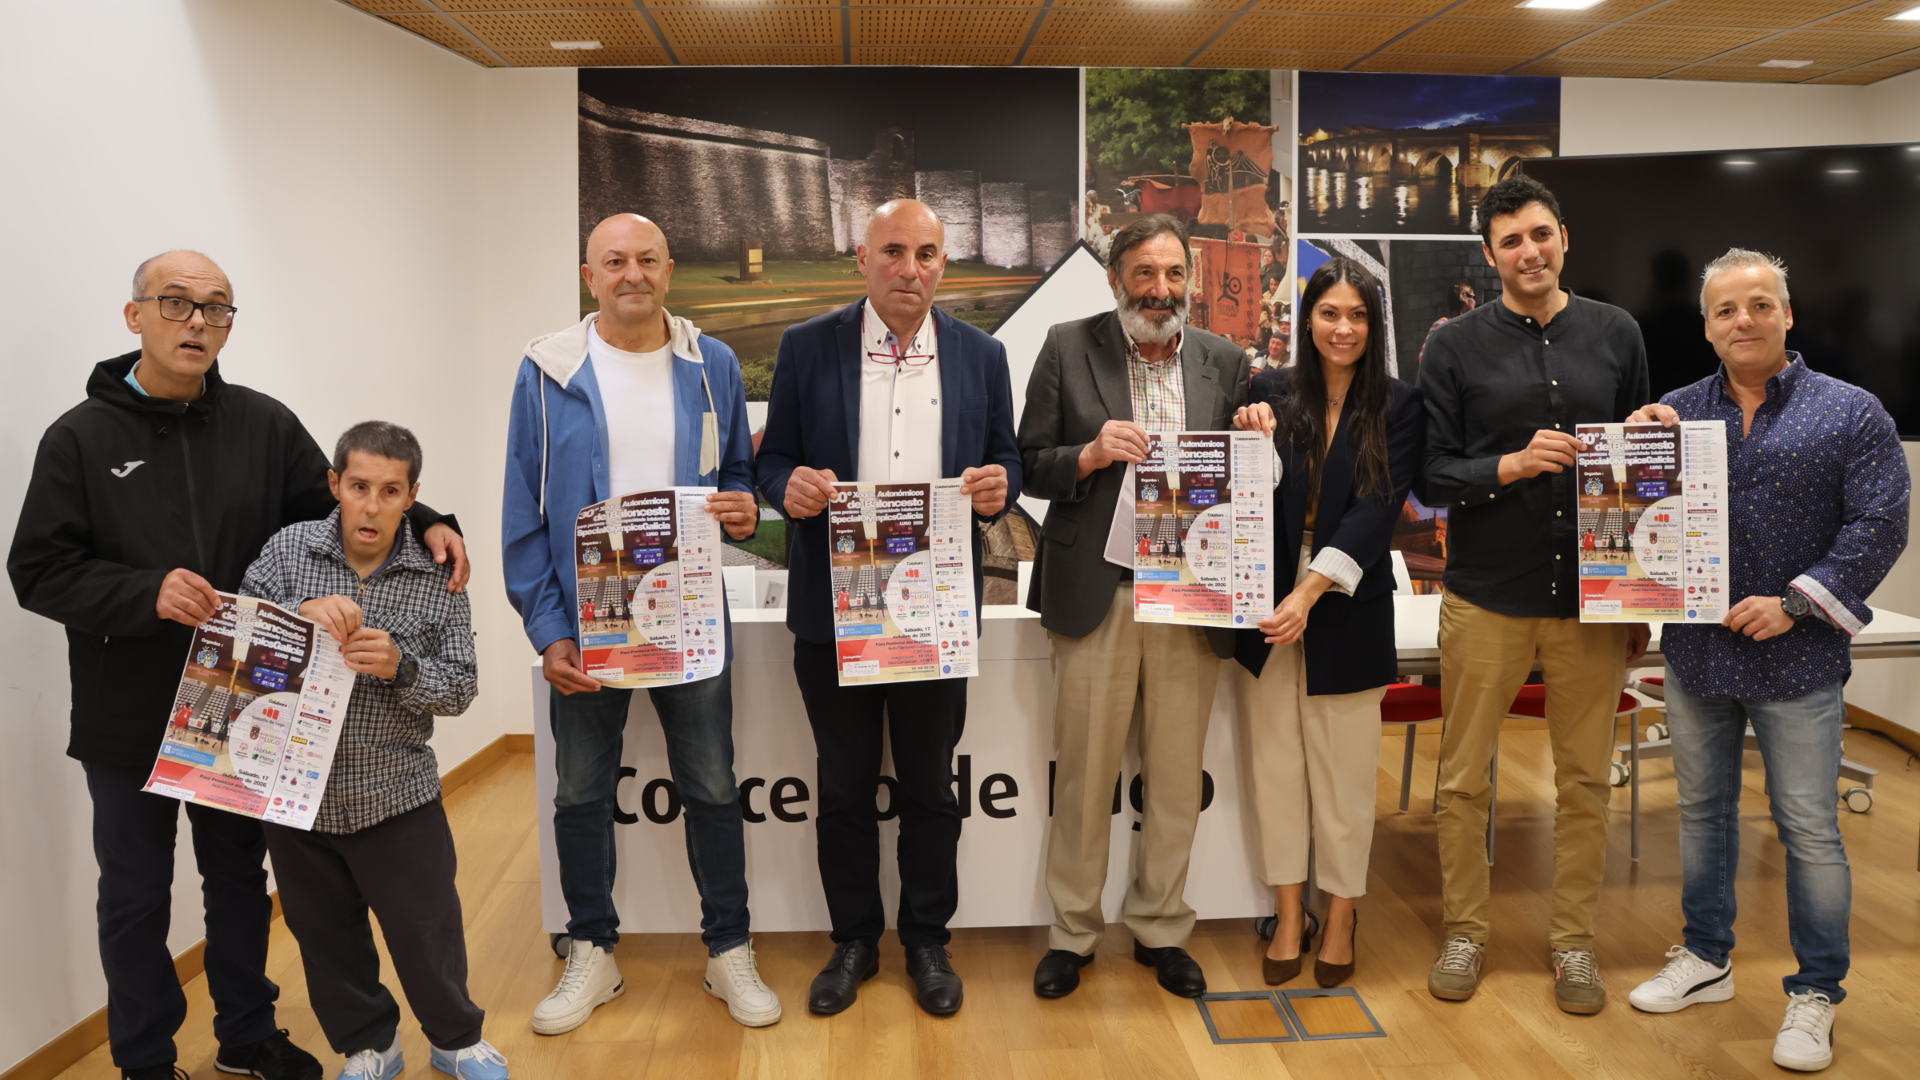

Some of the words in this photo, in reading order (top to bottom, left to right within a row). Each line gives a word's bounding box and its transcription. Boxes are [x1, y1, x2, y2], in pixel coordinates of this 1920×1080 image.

[1595, 442, 1610, 451] de
[1613, 440, 1675, 451] Baloncesto
[1151, 450, 1165, 458] de
[1168, 450, 1225, 459] Baloncesto
[877, 490, 924, 498] Autonómicos
[622, 497, 670, 507] Autonómicos
[847, 500, 862, 509] de
[865, 498, 924, 508] Baloncesto
[593, 513, 606, 521] de
[610, 506, 670, 519] Baloncesto
[230, 603, 257, 615] Xogos
[258, 609, 307, 633] Autonómicos
[222, 611, 238, 620] de
[242, 616, 306, 642] Baloncesto
